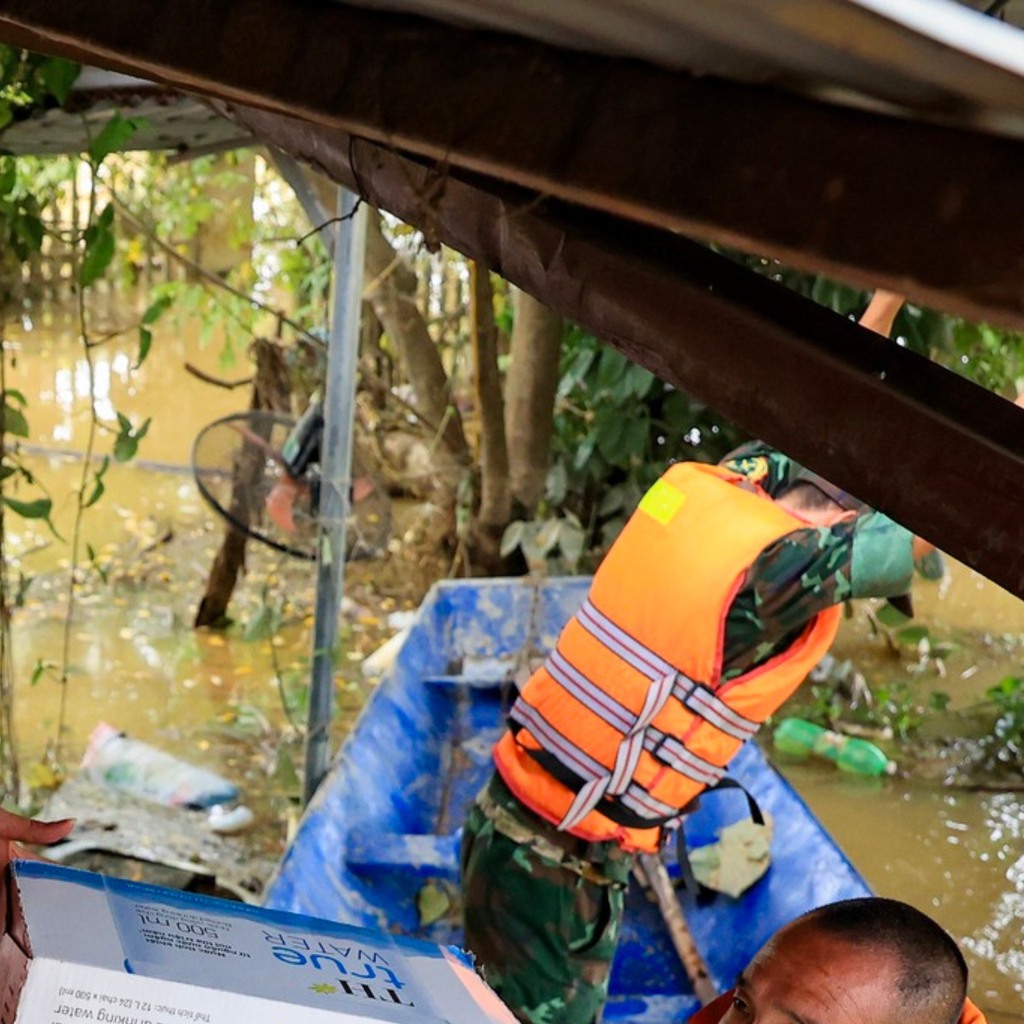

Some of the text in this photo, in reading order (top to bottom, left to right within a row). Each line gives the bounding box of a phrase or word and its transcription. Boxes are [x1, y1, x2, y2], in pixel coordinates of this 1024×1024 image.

[137, 913, 170, 927] ml
[175, 921, 219, 939] 500
[262, 931, 390, 966] WATER
[272, 946, 405, 990] true
[75, 989, 91, 1001] 500
[99, 995, 118, 1007] chai
[335, 978, 414, 1007] TH
[54, 1004, 94, 1021] water
[141, 1002, 152, 1012] 12
